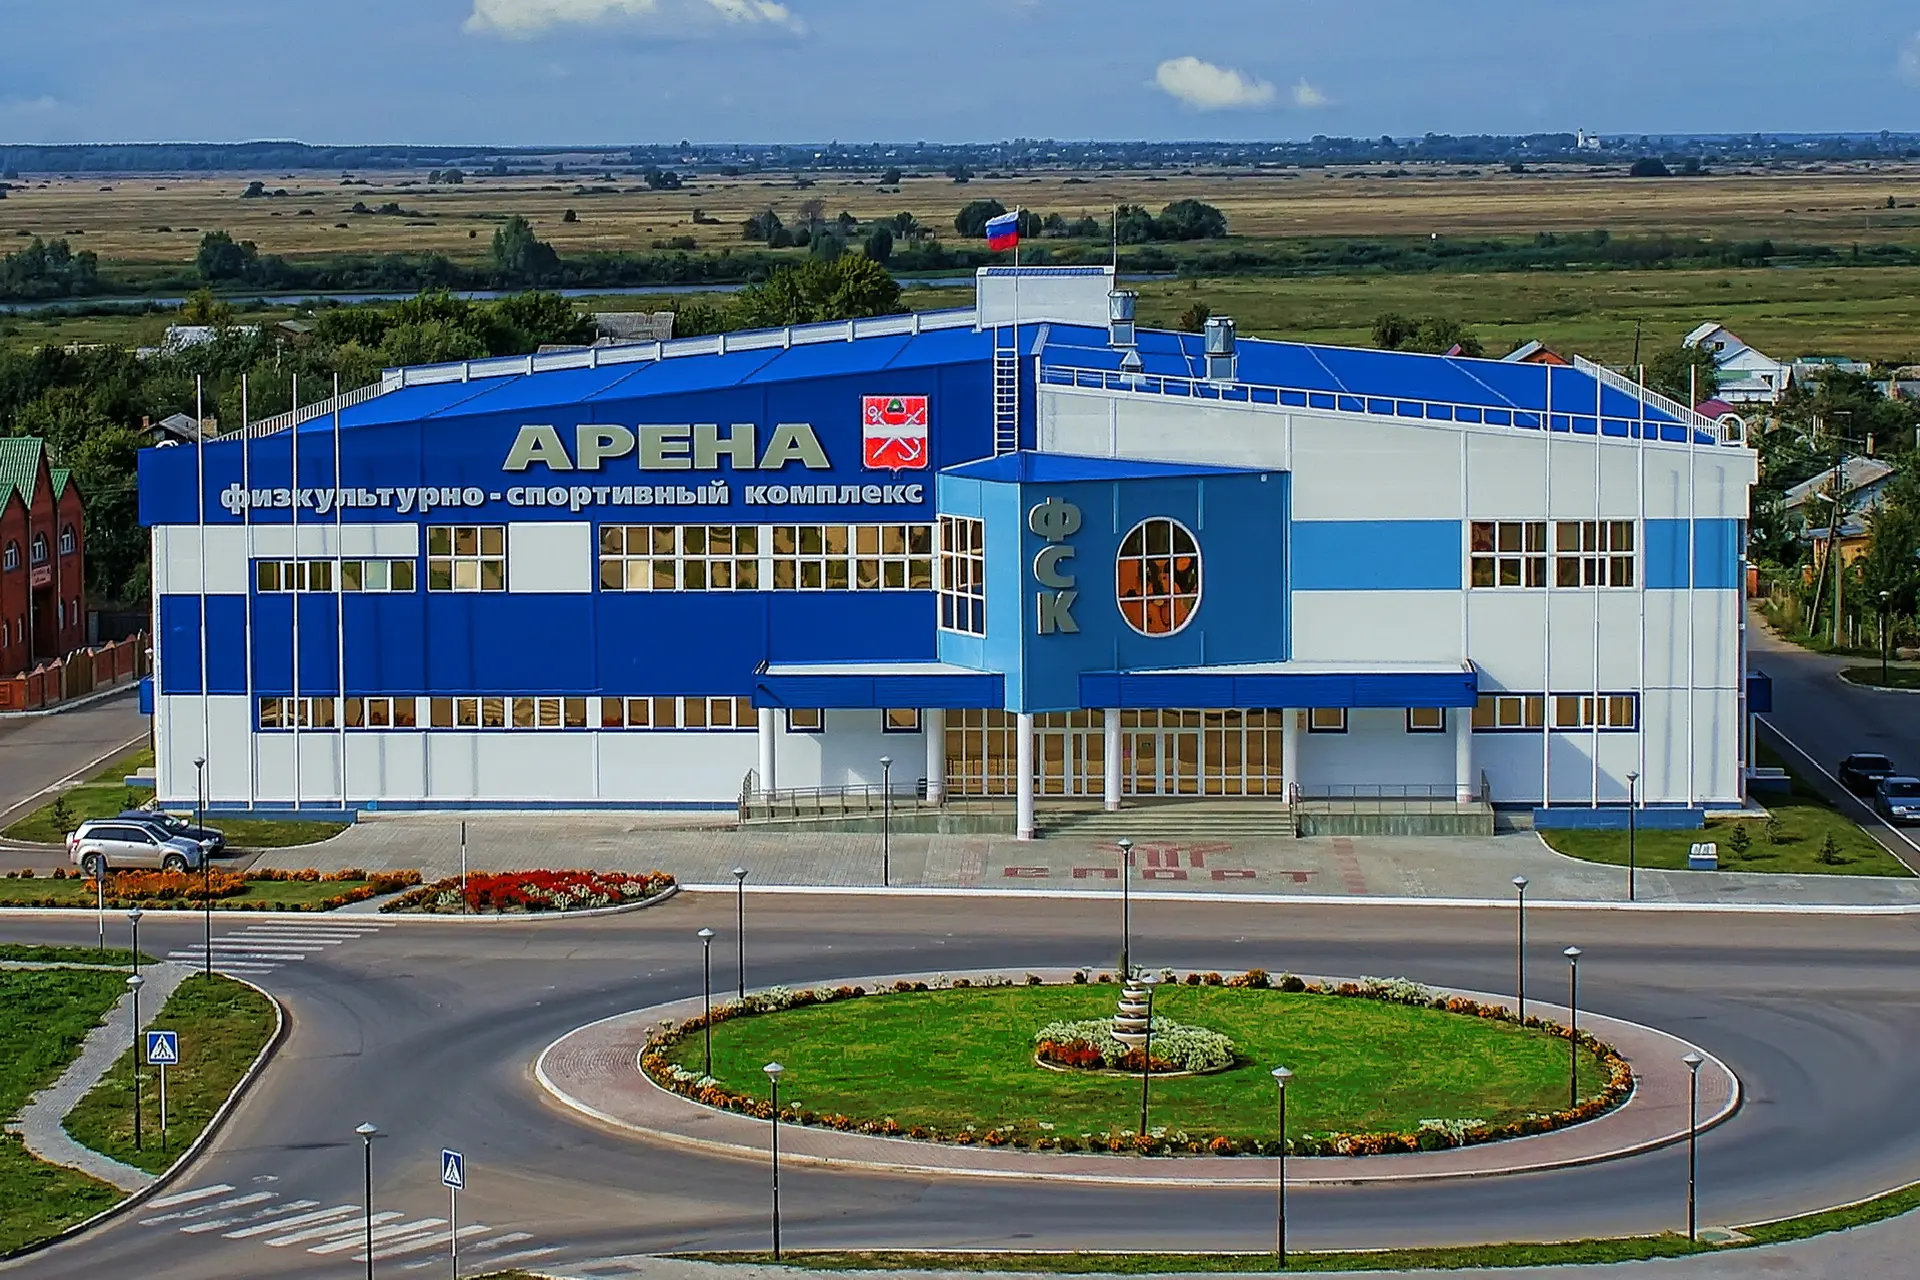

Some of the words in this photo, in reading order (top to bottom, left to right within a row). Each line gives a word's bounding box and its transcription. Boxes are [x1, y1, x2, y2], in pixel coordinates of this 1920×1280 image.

[503, 423, 831, 470] АРЕНА
[745, 483, 923, 505] комплекс
[1028, 497, 1081, 635] ФСК
[1004, 866, 1319, 882] СПОРТ
